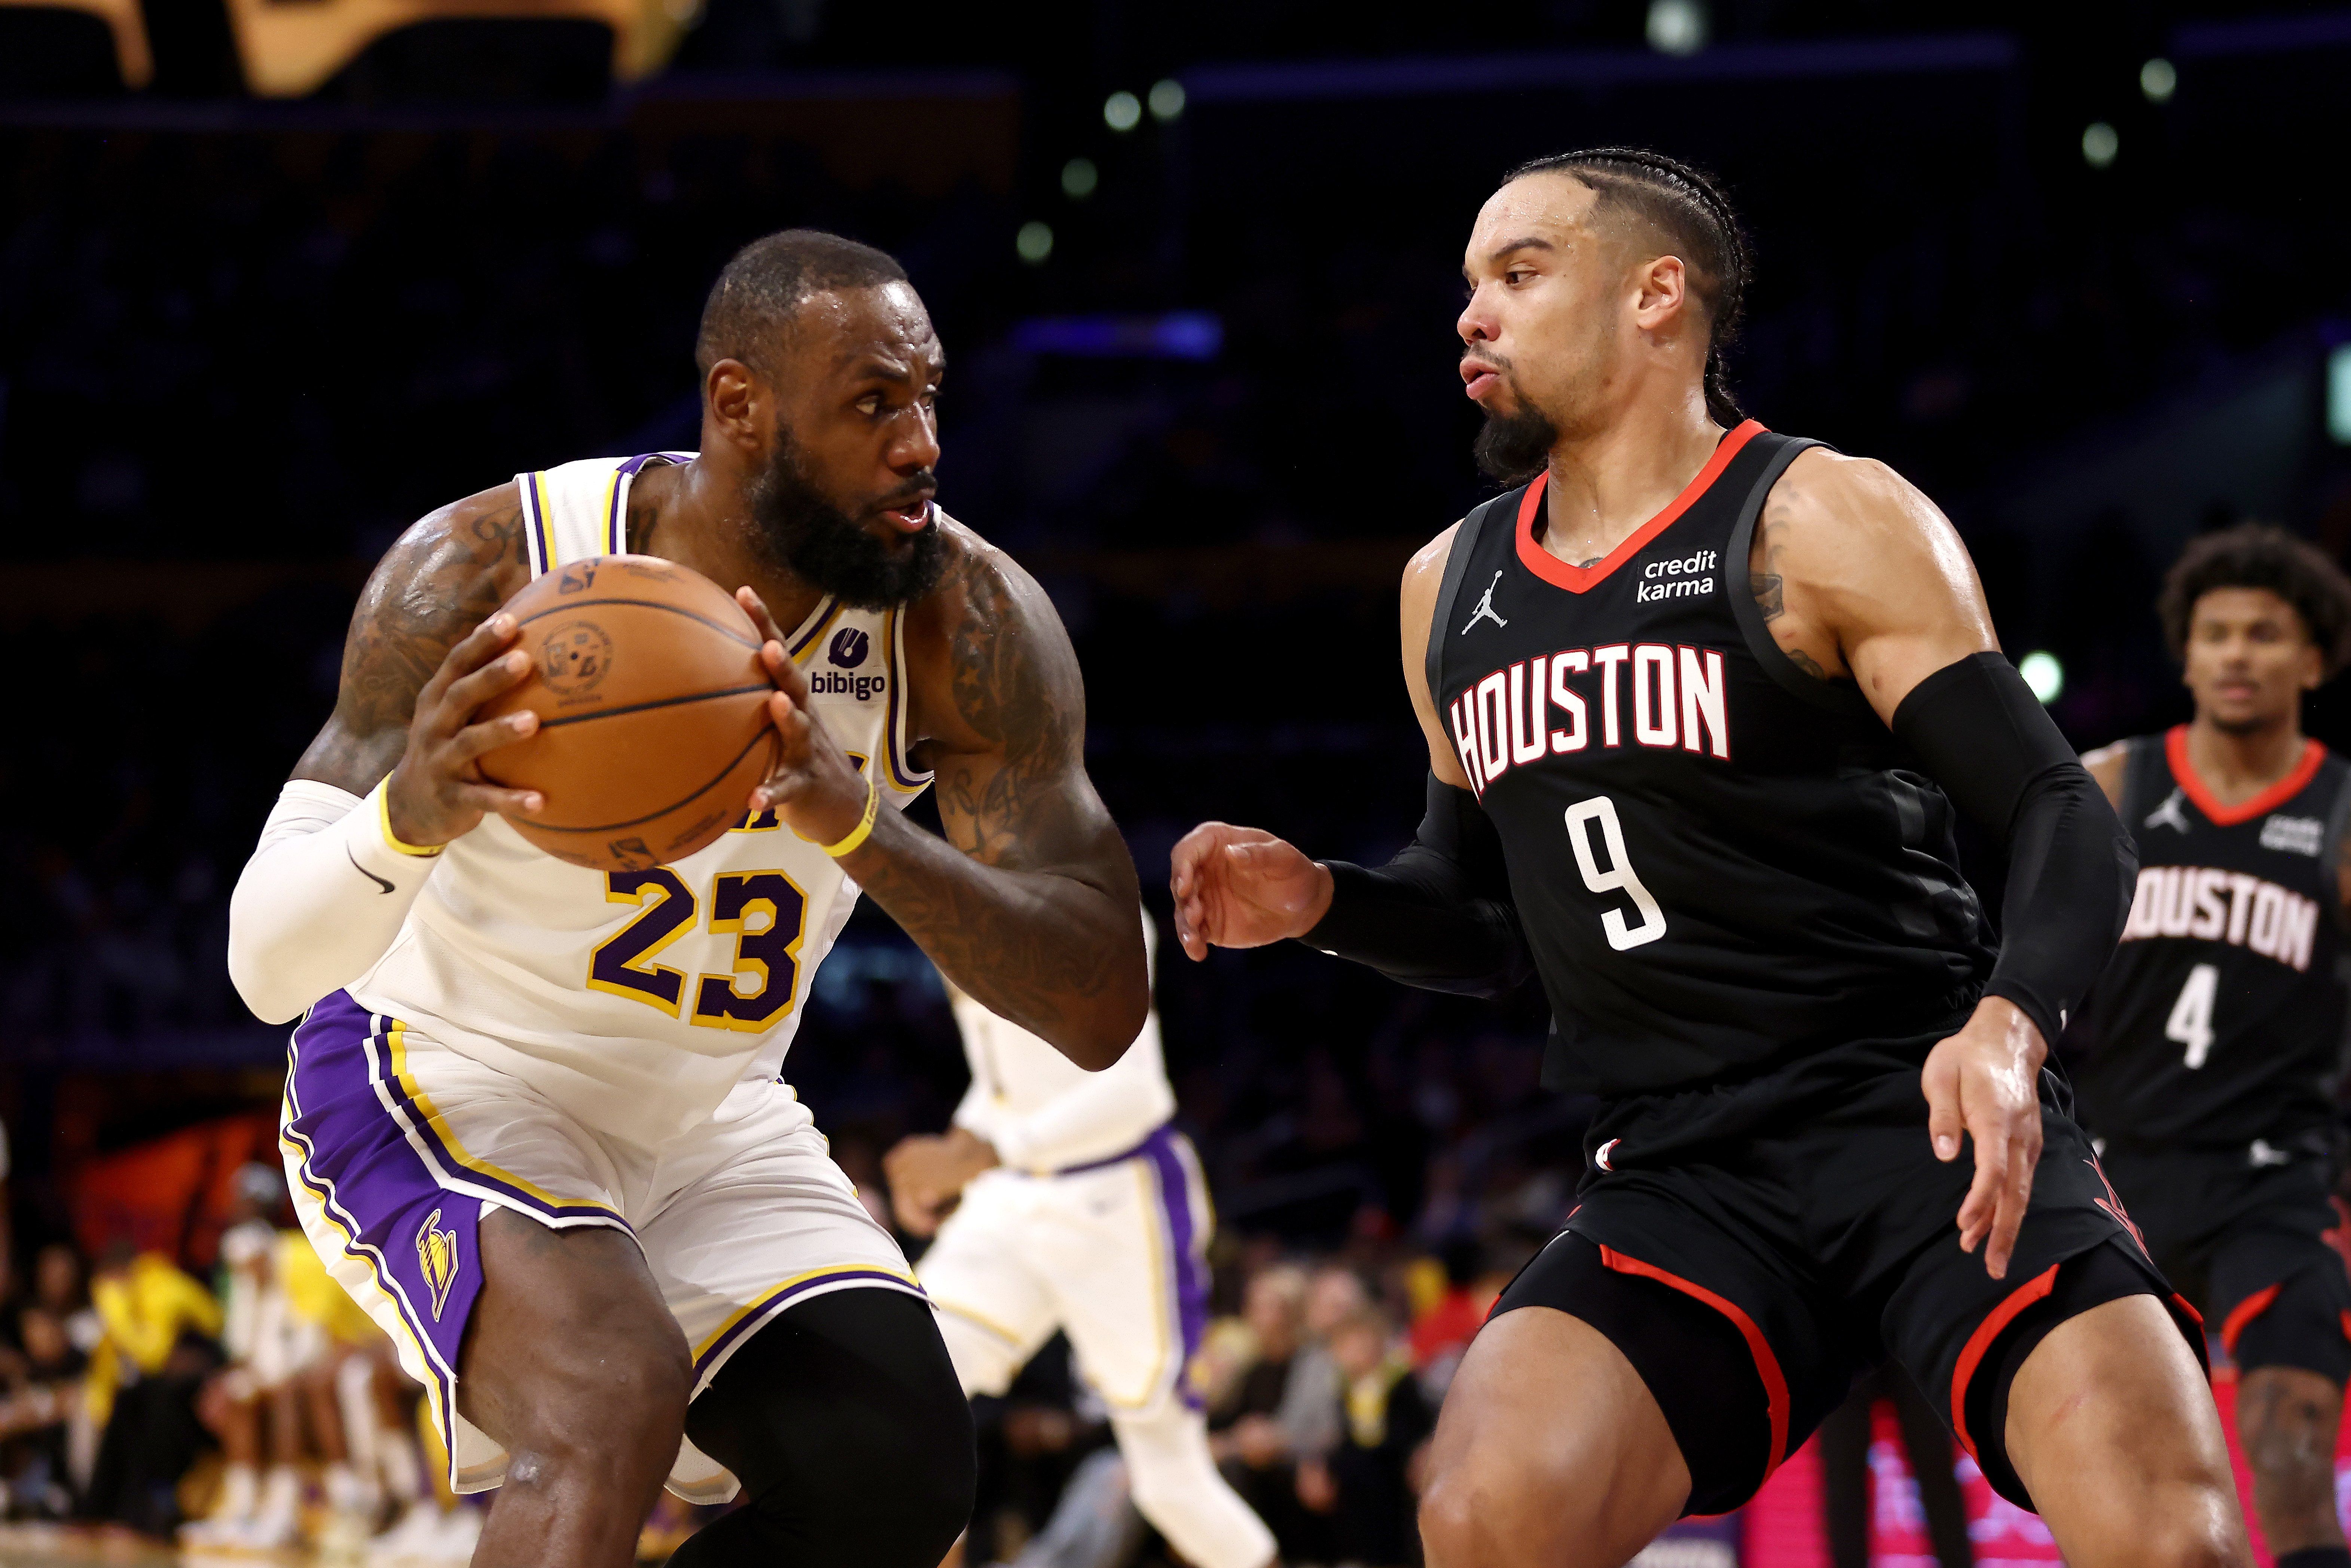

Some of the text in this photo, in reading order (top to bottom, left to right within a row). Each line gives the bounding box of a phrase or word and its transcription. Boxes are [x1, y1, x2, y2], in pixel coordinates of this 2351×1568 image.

[1637, 577, 1714, 603] karma
[1645, 550, 1717, 579] credit
[811, 671, 885, 701] bibigo
[1450, 642, 1731, 805] HOUSTON
[1564, 795, 1668, 952] 9
[2120, 865, 2321, 973] OUSTON
[587, 865, 807, 1034] 23
[2164, 962, 2220, 1070] 4
